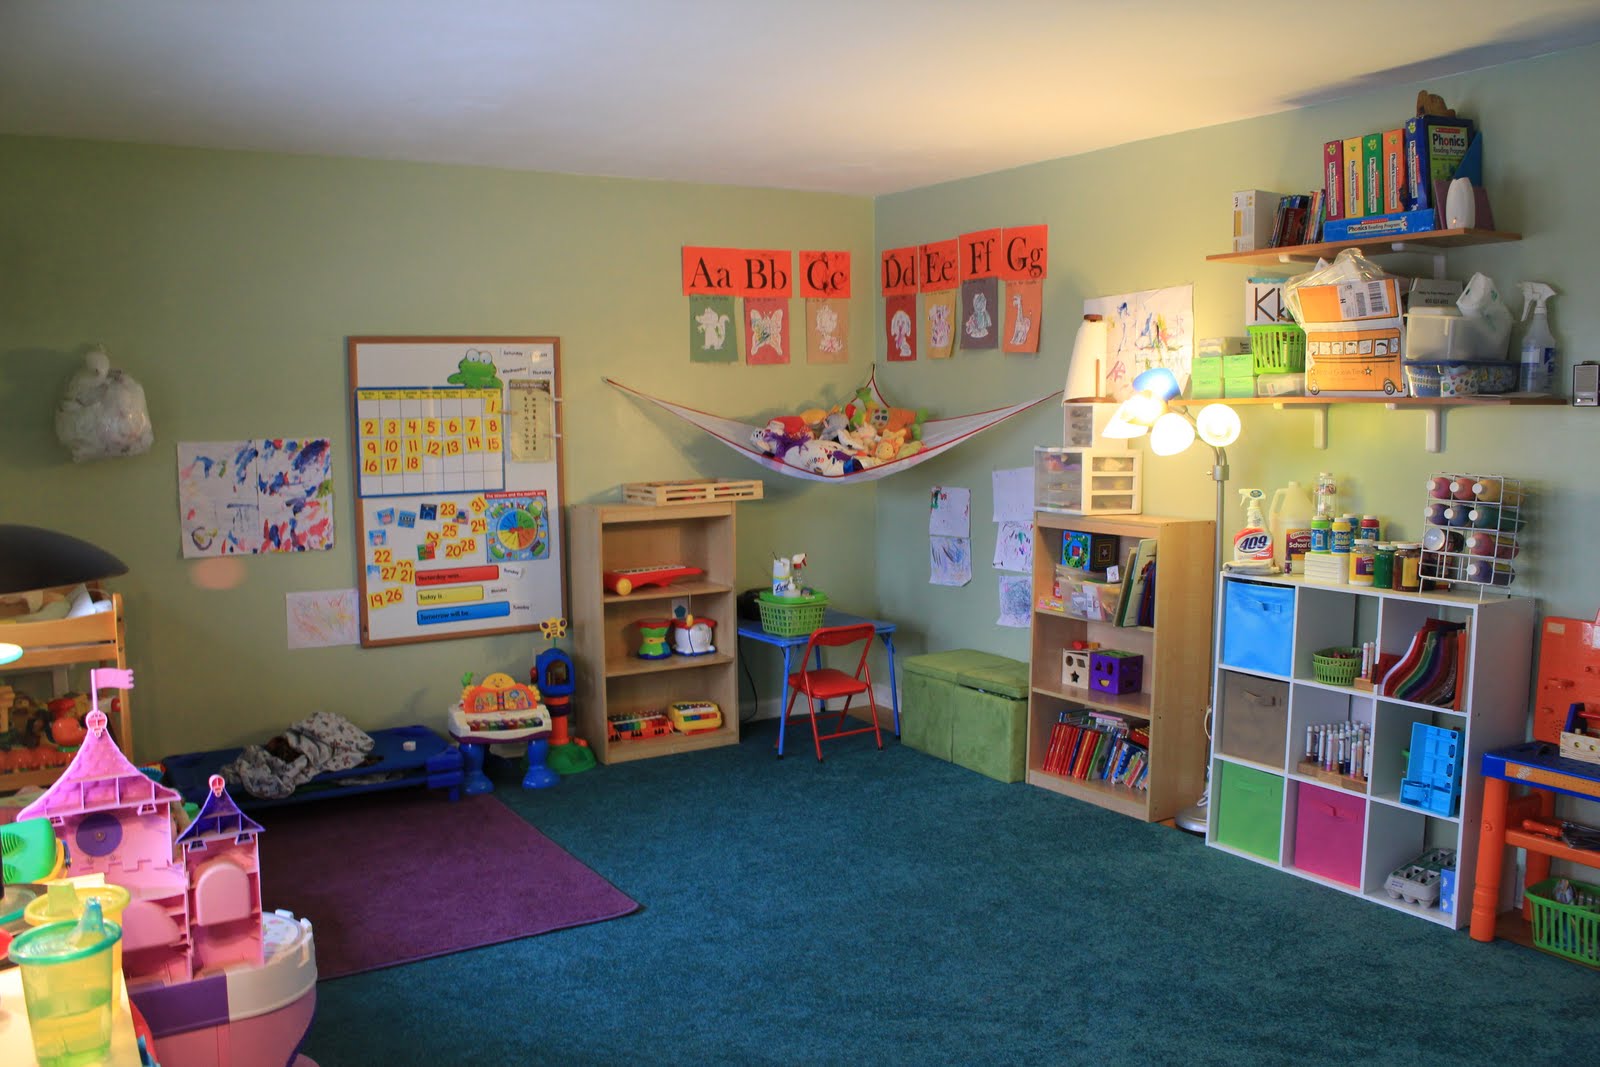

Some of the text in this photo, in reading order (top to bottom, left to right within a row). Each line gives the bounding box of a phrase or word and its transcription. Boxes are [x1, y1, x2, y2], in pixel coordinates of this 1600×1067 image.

[1432, 133, 1464, 146] Phonics
[969, 238, 995, 275] Ff
[1006, 236, 1044, 278] Gg
[689, 256, 734, 288] Aa
[744, 258, 787, 290] Bb
[806, 258, 844, 291] Cc
[884, 256, 916, 288] Dd
[926, 252, 953, 284] Ee
[491, 400, 495, 412] 1
[365, 419, 497, 434] 2 3 4 5 6 7 8
[367, 436, 499, 455] 9 10 11 12 13 14 15
[365, 457, 418, 472] 16 17 18
[441, 504, 455, 516] 23
[472, 497, 486, 512] 31
[442, 524, 456, 536] 25
[471, 519, 486, 532] 24
[460, 539, 475, 552] 28
[1240, 536, 1268, 550] 409
[374, 550, 390, 562] 22
[446, 545, 462, 557] 20
[382, 567, 396, 580] 27
[400, 570, 412, 582] 21
[418, 574, 446, 582] Yesterday
[371, 594, 382, 607] 19
[386, 589, 402, 602] 26
